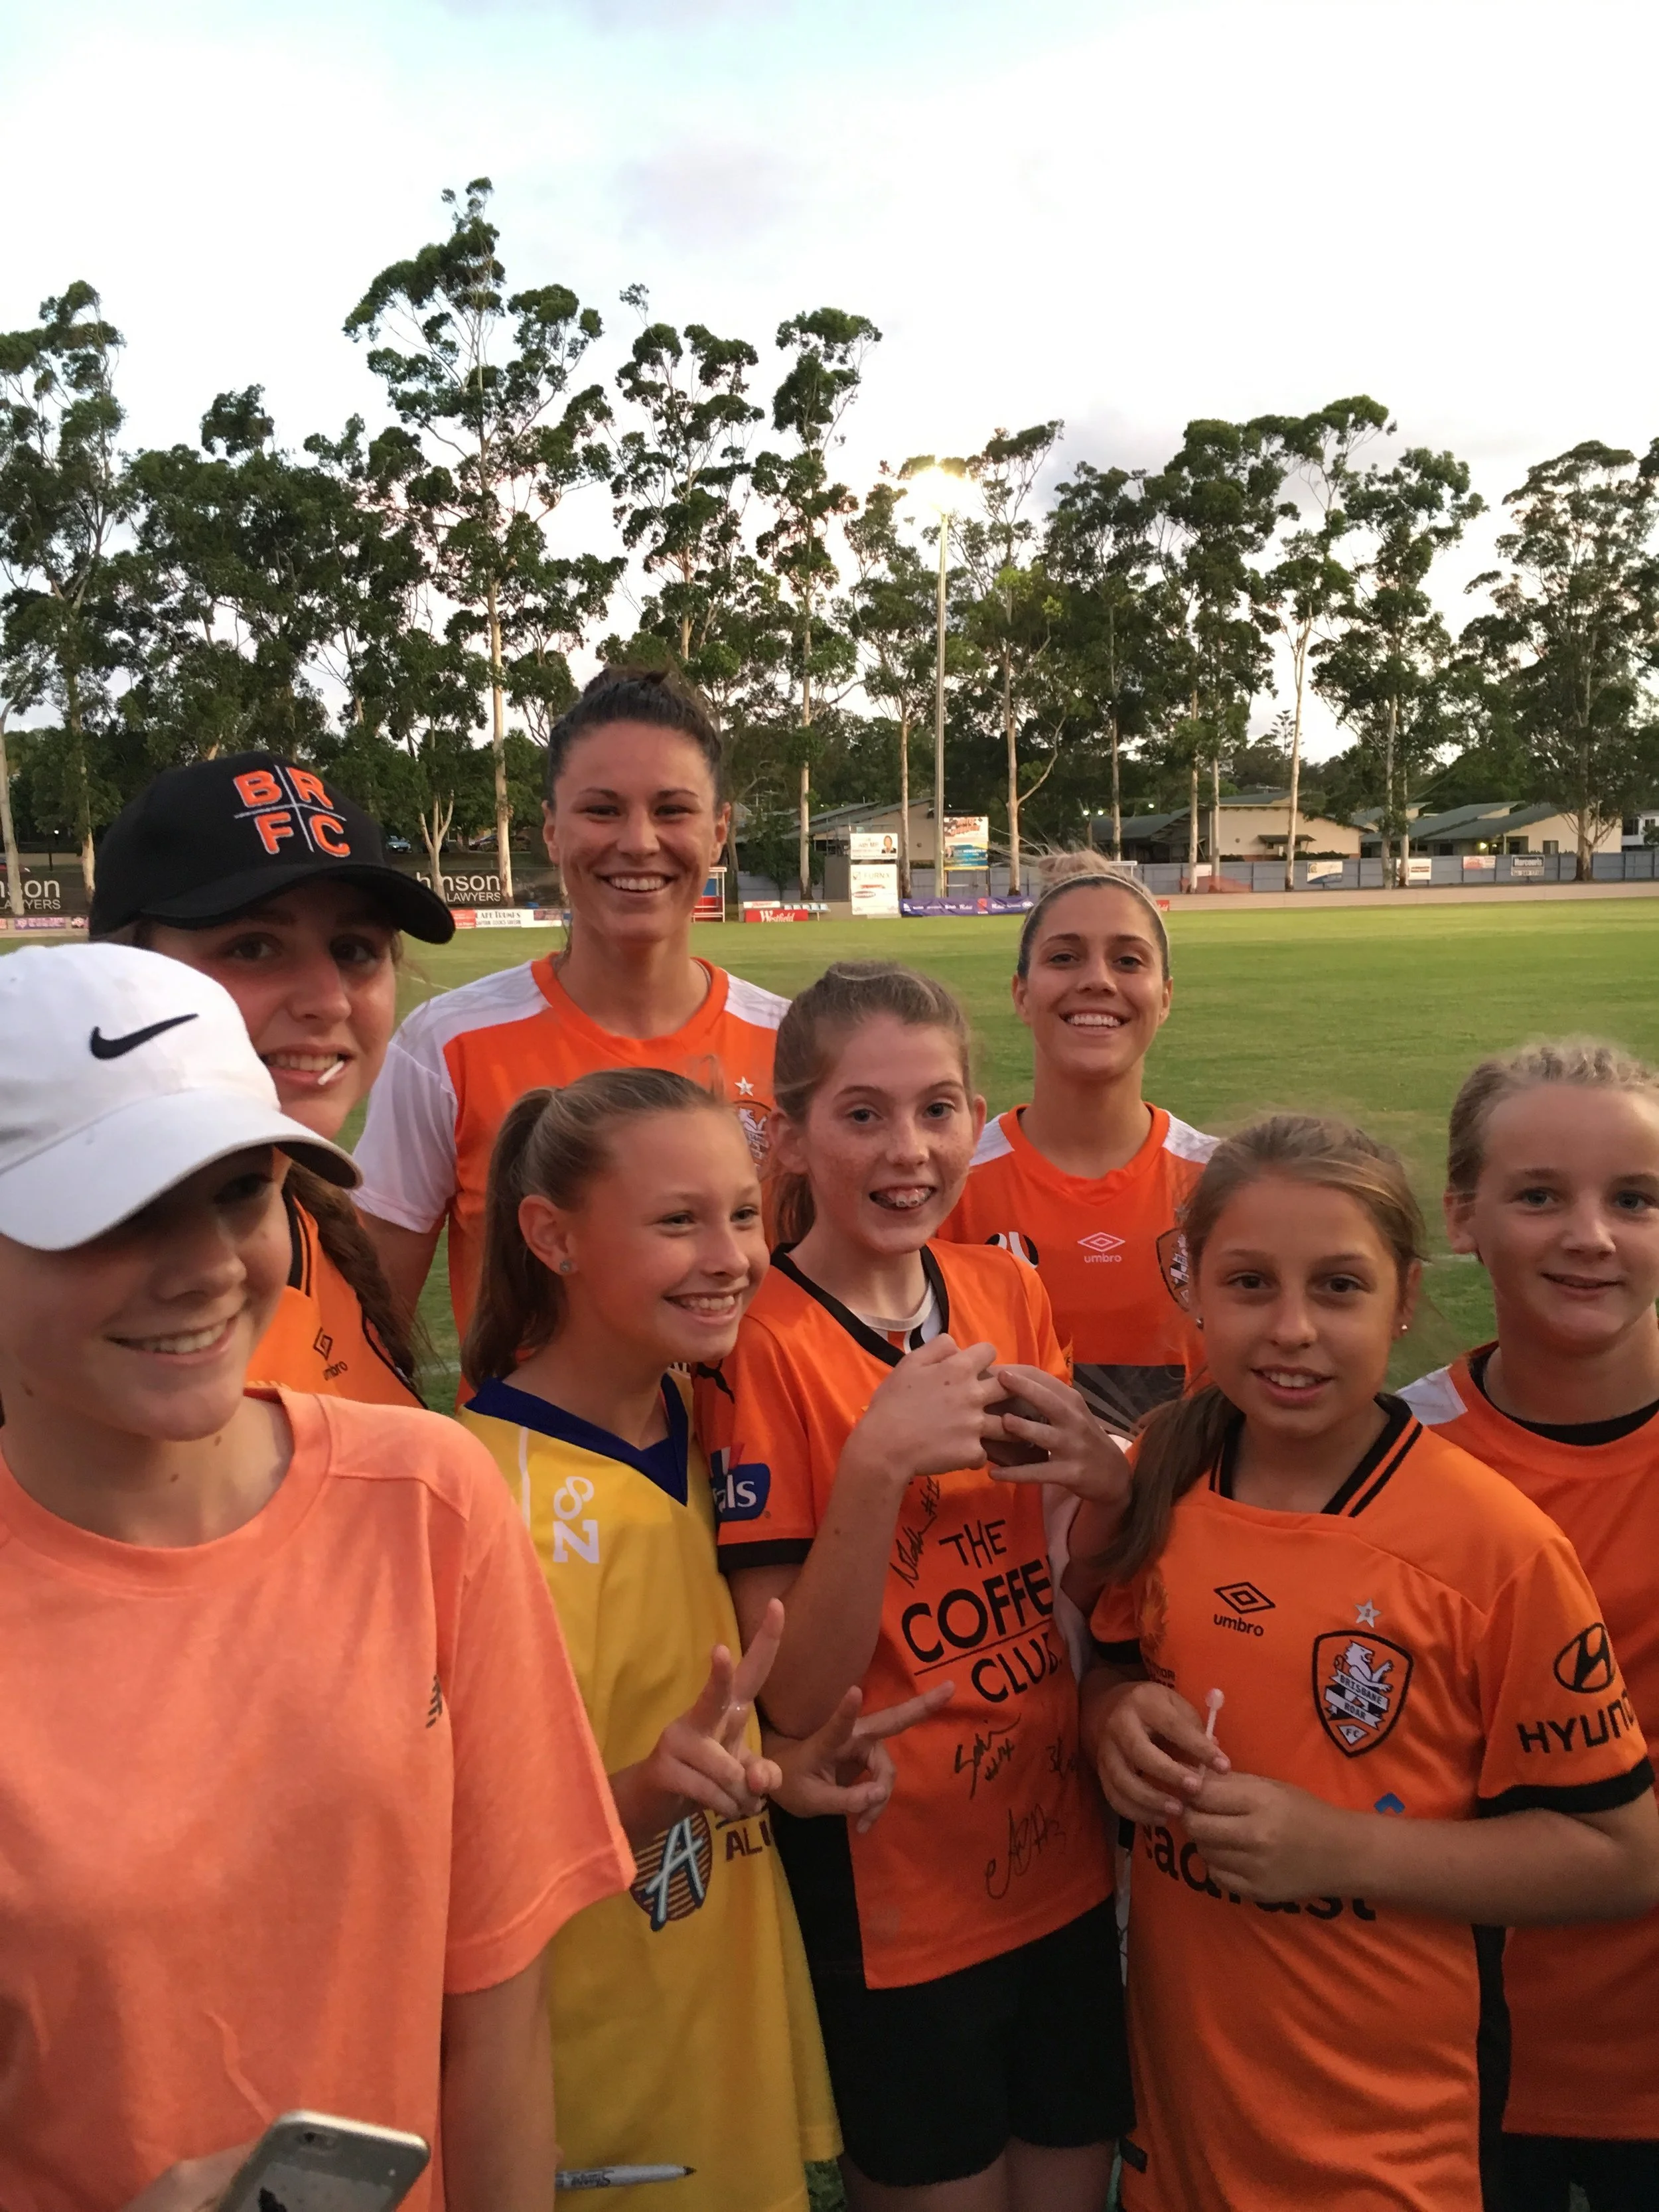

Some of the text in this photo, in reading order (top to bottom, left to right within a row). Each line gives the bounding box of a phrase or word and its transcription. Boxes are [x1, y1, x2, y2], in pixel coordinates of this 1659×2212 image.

[447, 892, 501, 903] LAWYERS
[759, 910, 795, 922] Westfield
[1084, 1254, 1122, 1264] umbro
[939, 1519, 1008, 1569] THE
[901, 1556, 1055, 1663] COFFE
[1213, 1612, 1265, 1637] umbro
[1339, 1674, 1384, 1705] BRISBANE
[1344, 1702, 1367, 1721] ROAR
[1345, 1728, 1360, 1738] FC
